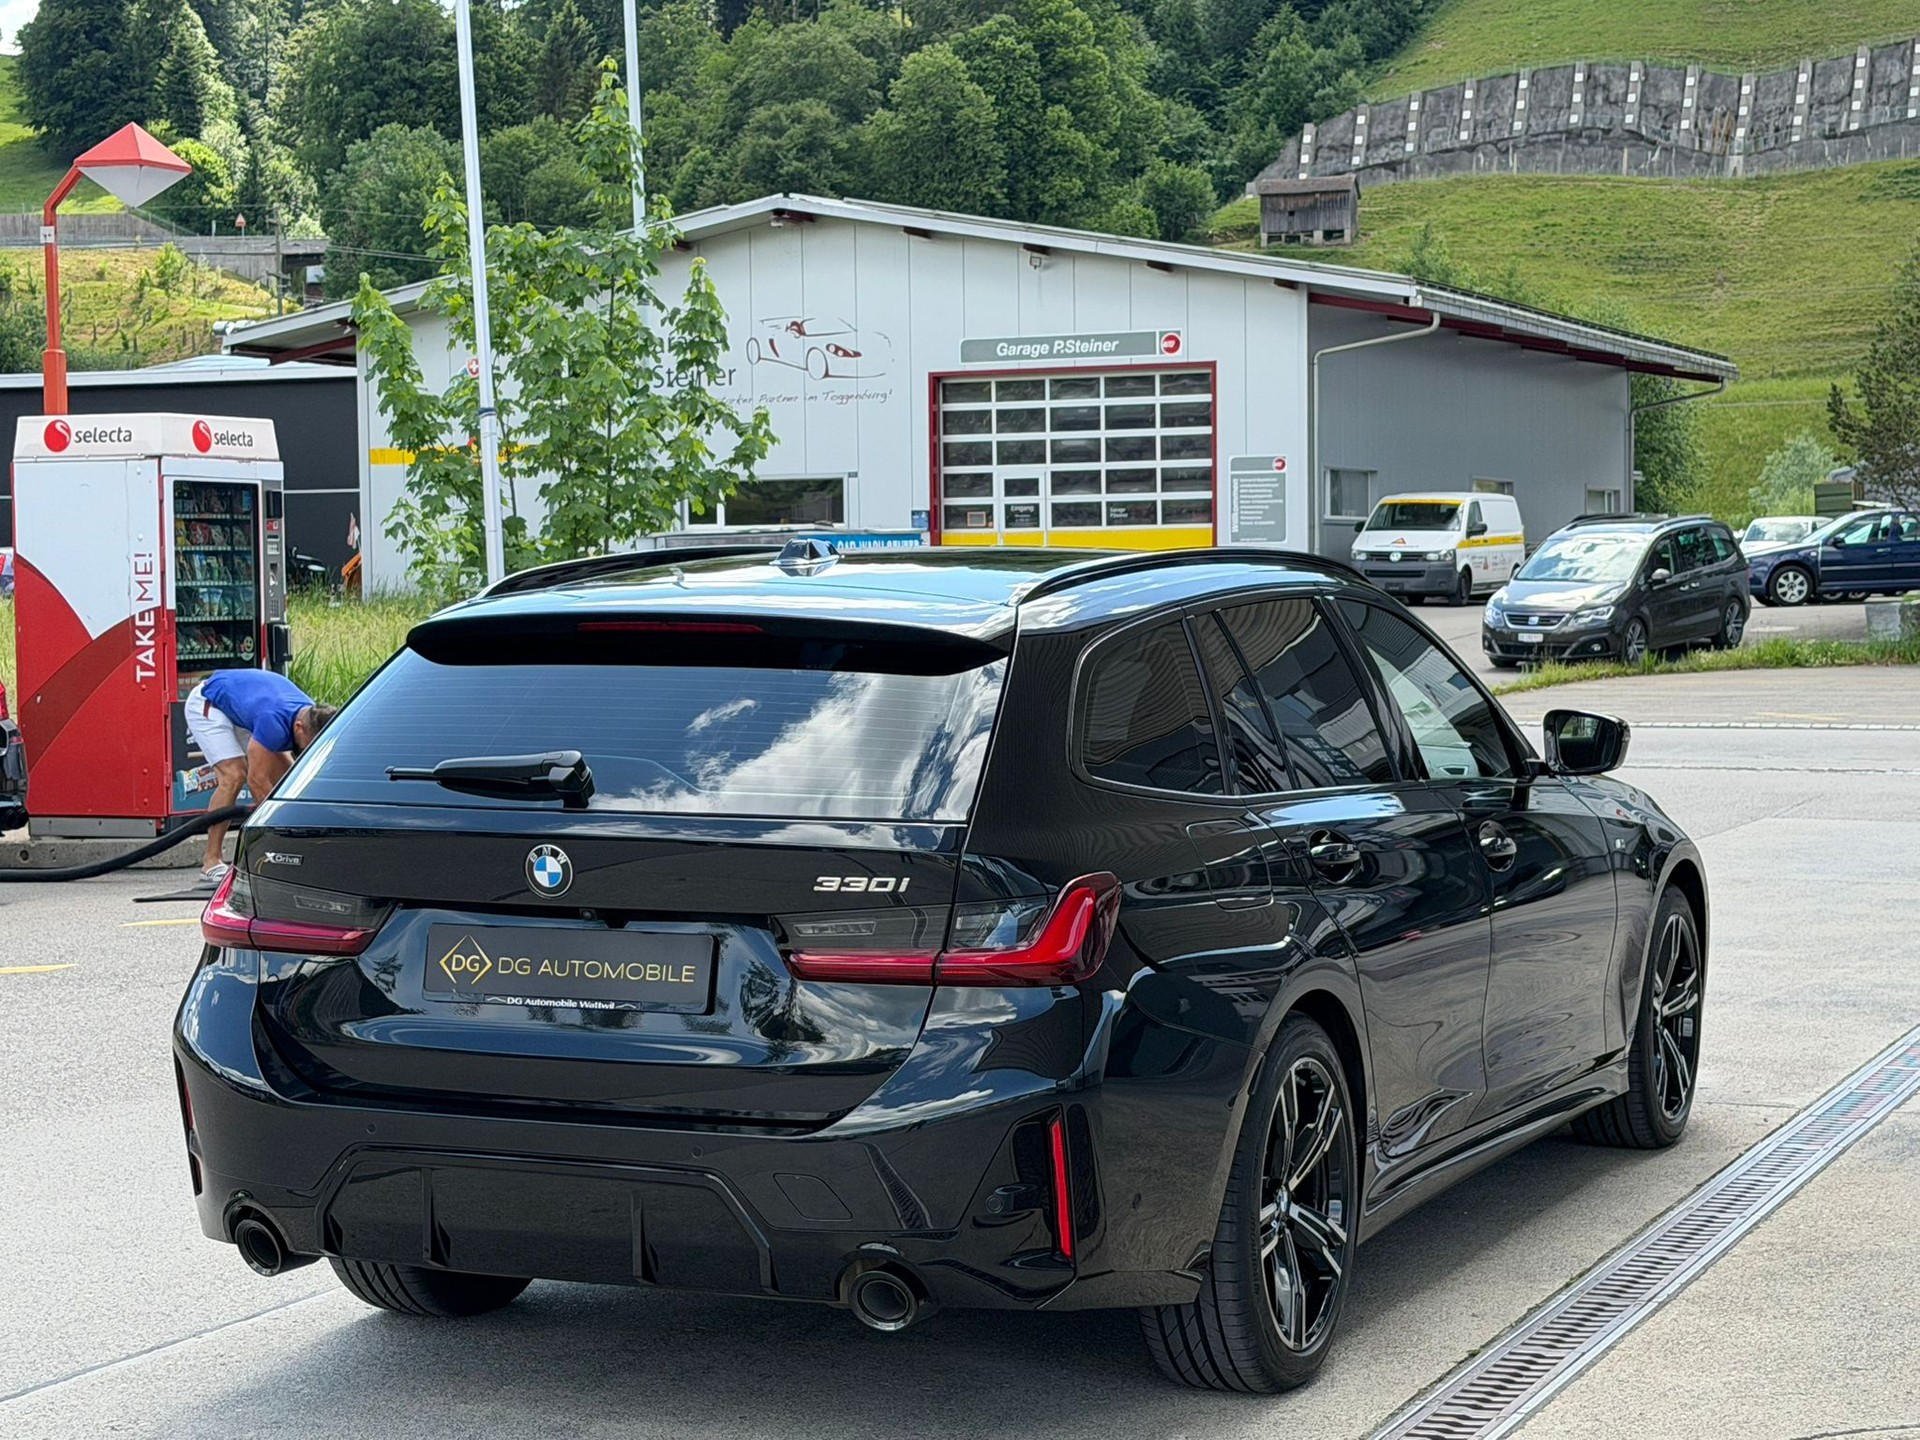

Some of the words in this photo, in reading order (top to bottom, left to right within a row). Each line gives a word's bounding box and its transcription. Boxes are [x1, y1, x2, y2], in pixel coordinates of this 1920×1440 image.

[996, 342, 1049, 358] Garage
[1053, 338, 1119, 355] P.Steiner
[74, 427, 133, 443] selecta
[214, 430, 254, 448] selecta
[134, 552, 154, 602] ME!
[134, 609, 156, 684] TAKE
[529, 846, 568, 865] BMW
[451, 954, 481, 973] DG
[497, 957, 531, 975] DG
[537, 959, 696, 983] AUTOMOBILE
[506, 997, 523, 1006] DG
[524, 997, 578, 1008] Automobile
[579, 1000, 615, 1010] Wattwil
